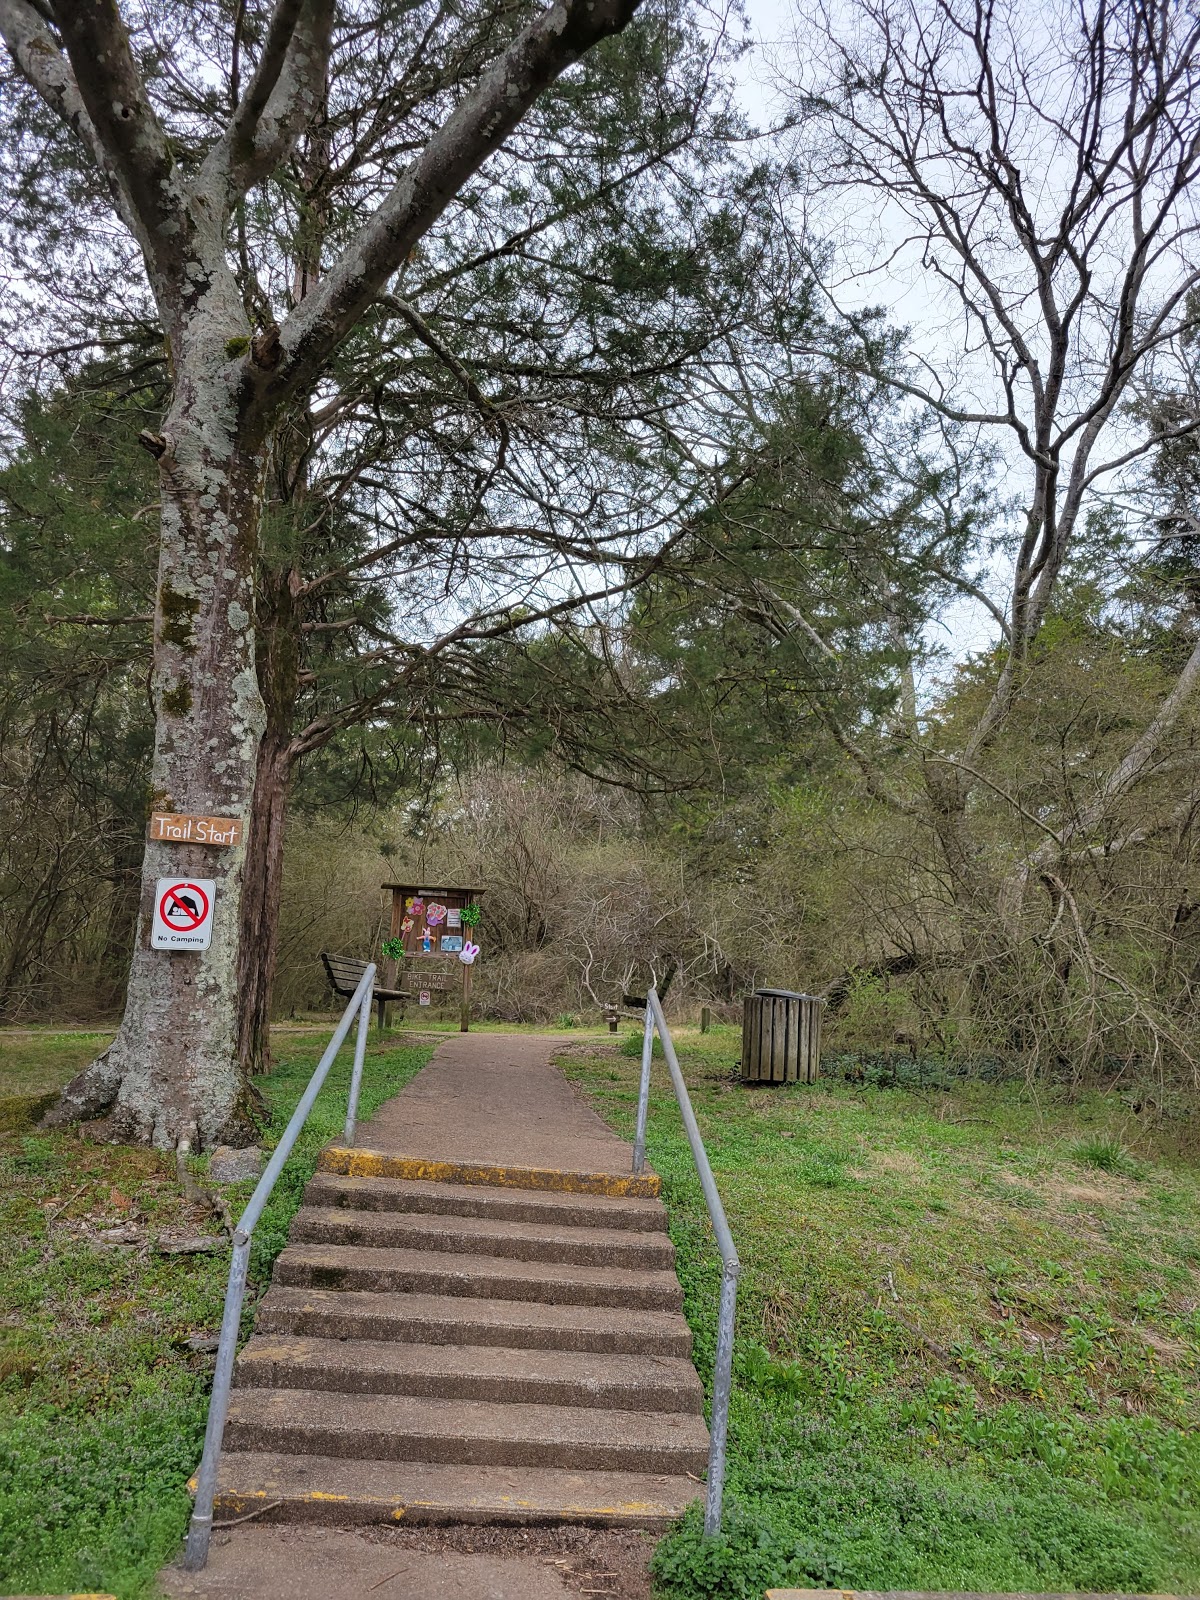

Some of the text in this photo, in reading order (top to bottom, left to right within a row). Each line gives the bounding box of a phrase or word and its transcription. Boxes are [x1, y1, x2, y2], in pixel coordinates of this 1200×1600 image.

[156, 817, 238, 844] Trail Start
[410, 980, 444, 989] ENTRANCE
